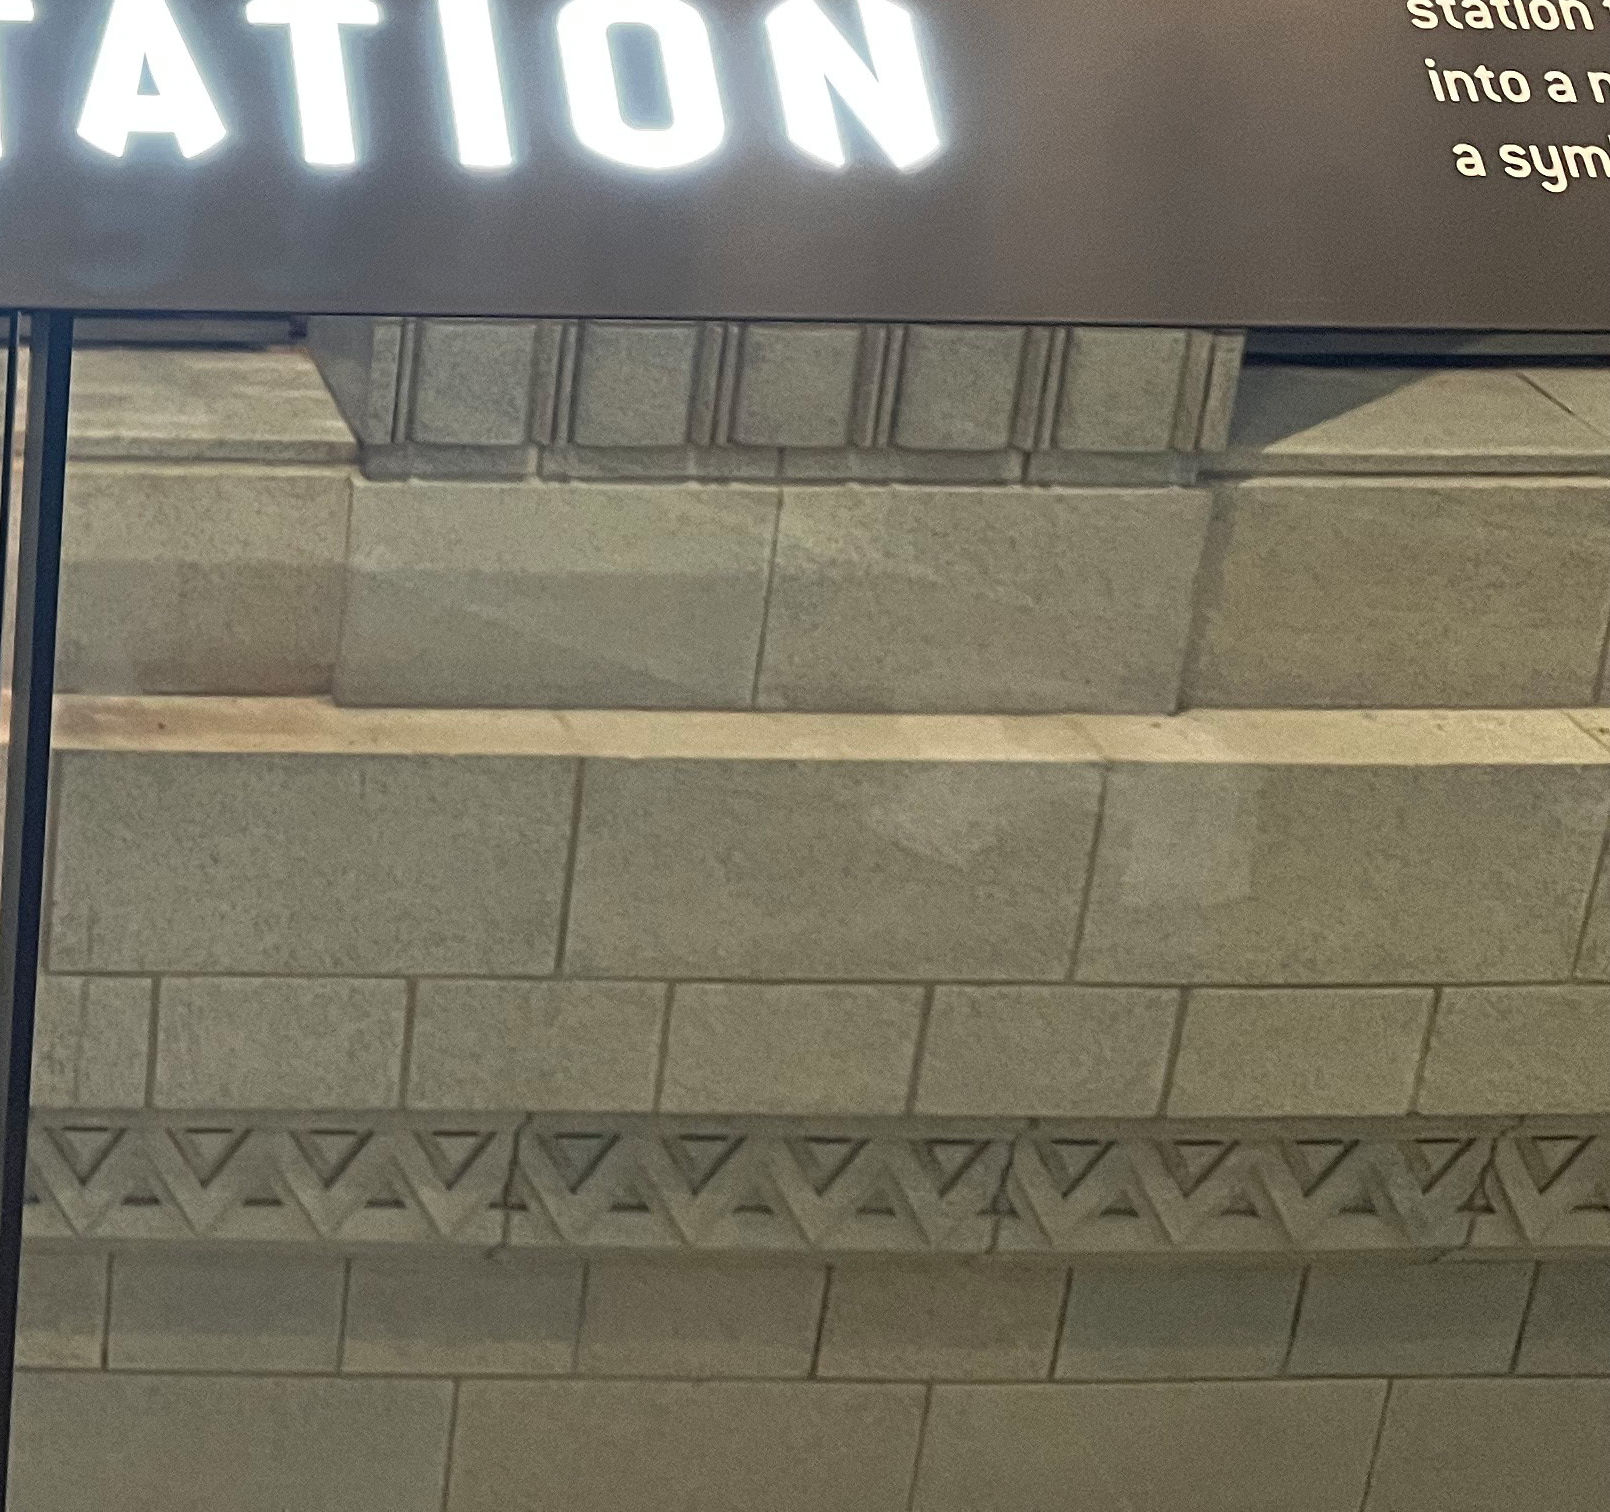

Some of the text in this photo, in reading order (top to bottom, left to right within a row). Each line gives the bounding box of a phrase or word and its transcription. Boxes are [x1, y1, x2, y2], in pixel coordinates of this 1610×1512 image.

[1424, 57, 1531, 103] into
[1543, 70, 1578, 103] a
[1452, 134, 1610, 193] a sym
